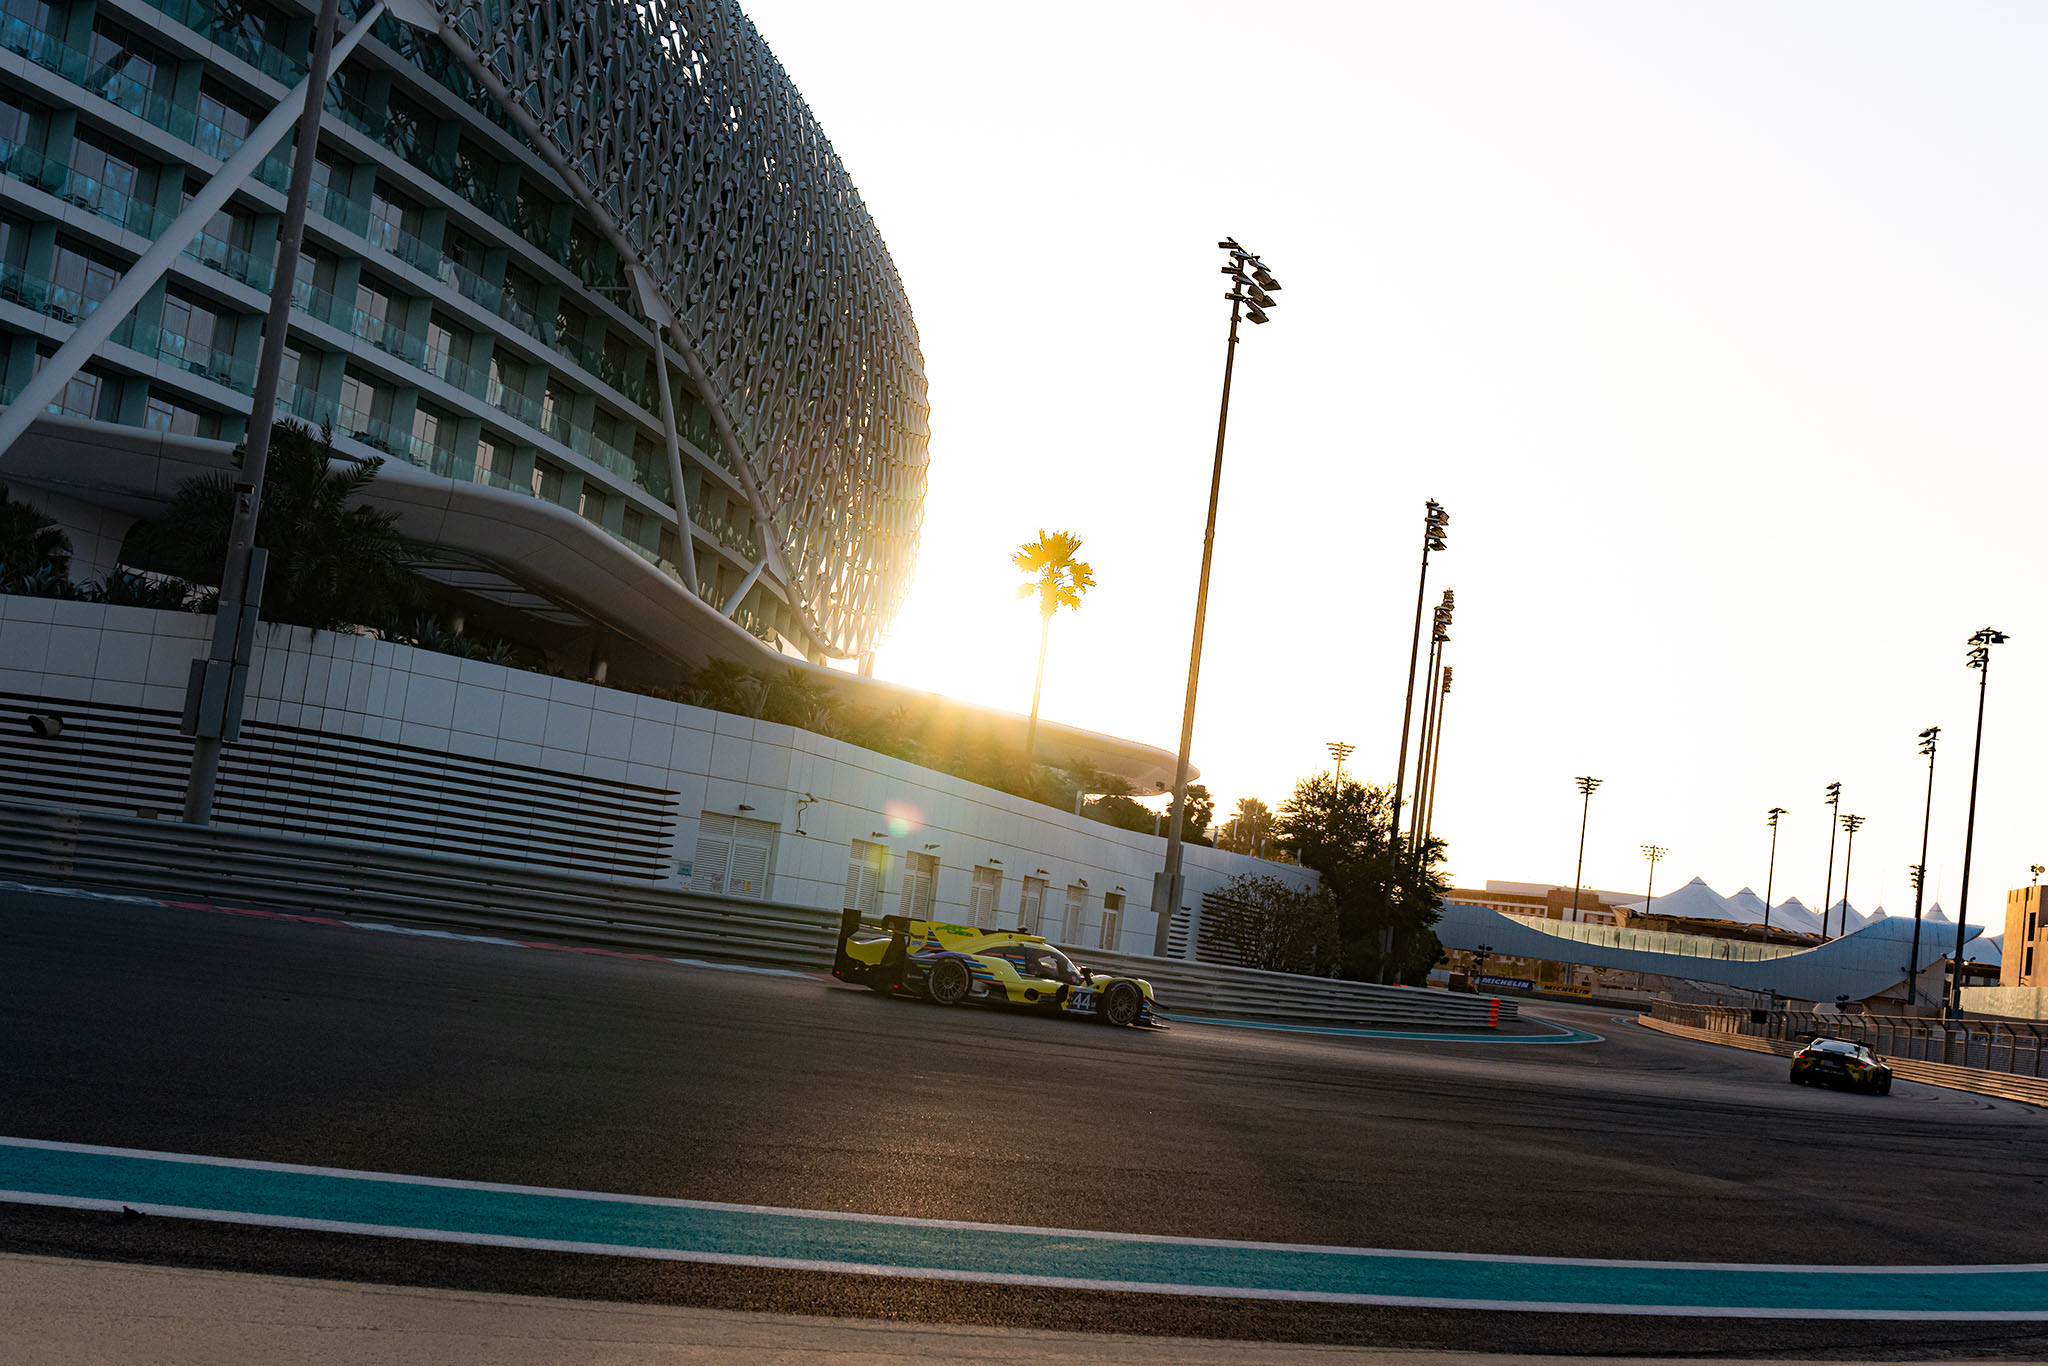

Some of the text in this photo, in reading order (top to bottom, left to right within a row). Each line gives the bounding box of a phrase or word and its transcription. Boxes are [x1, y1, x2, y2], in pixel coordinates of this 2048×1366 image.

[1481, 978, 1529, 989] MICHELIN
[1544, 985, 1590, 995] MICHELIN
[1072, 993, 1091, 1010] 44
